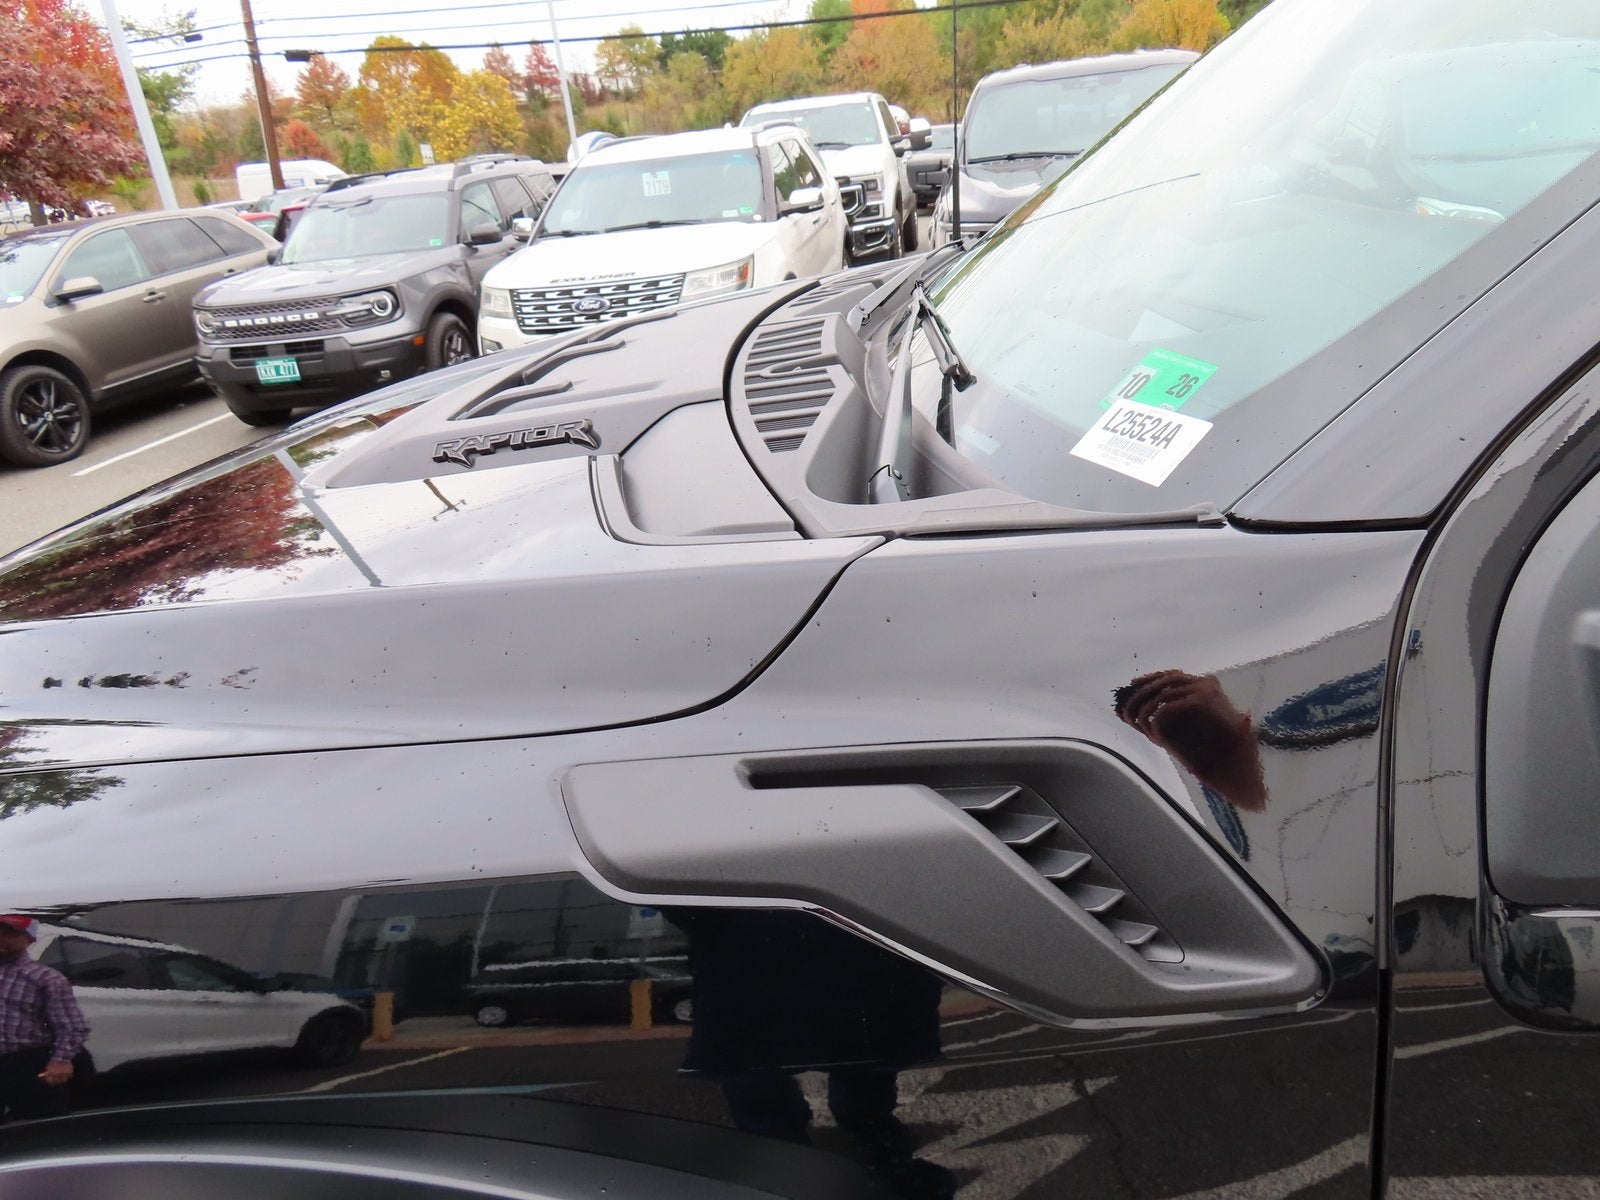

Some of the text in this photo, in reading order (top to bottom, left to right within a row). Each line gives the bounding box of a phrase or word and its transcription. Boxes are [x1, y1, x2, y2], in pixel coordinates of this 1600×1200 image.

[579, 299, 601, 311] Ford
[224, 312, 319, 328] BRONCO
[1117, 372, 1151, 400] 10
[1165, 373, 1200, 398] 26
[1102, 407, 1183, 450] L25524A
[432, 419, 602, 469] RAPTOR
